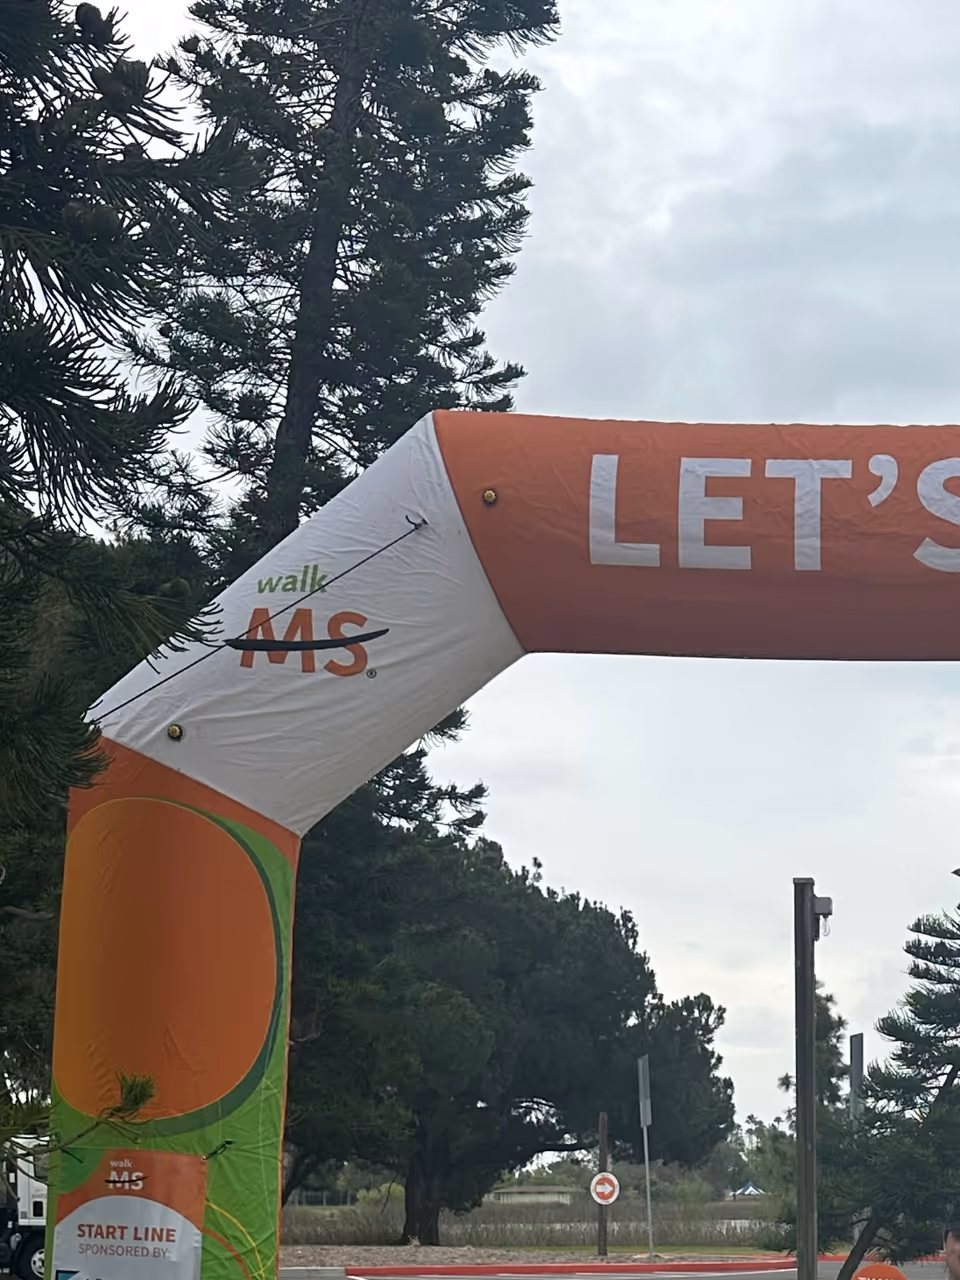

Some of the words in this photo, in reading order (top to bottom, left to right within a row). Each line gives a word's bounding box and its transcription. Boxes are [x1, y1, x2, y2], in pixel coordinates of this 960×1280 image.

[257, 564, 329, 594] walk
[239, 607, 369, 678] MS
[109, 1159, 133, 1169] walk
[108, 1170, 144, 1190] MS
[76, 1223, 129, 1241] START
[133, 1225, 177, 1243] LINE
[78, 1243, 150, 1258] SPONSORED
